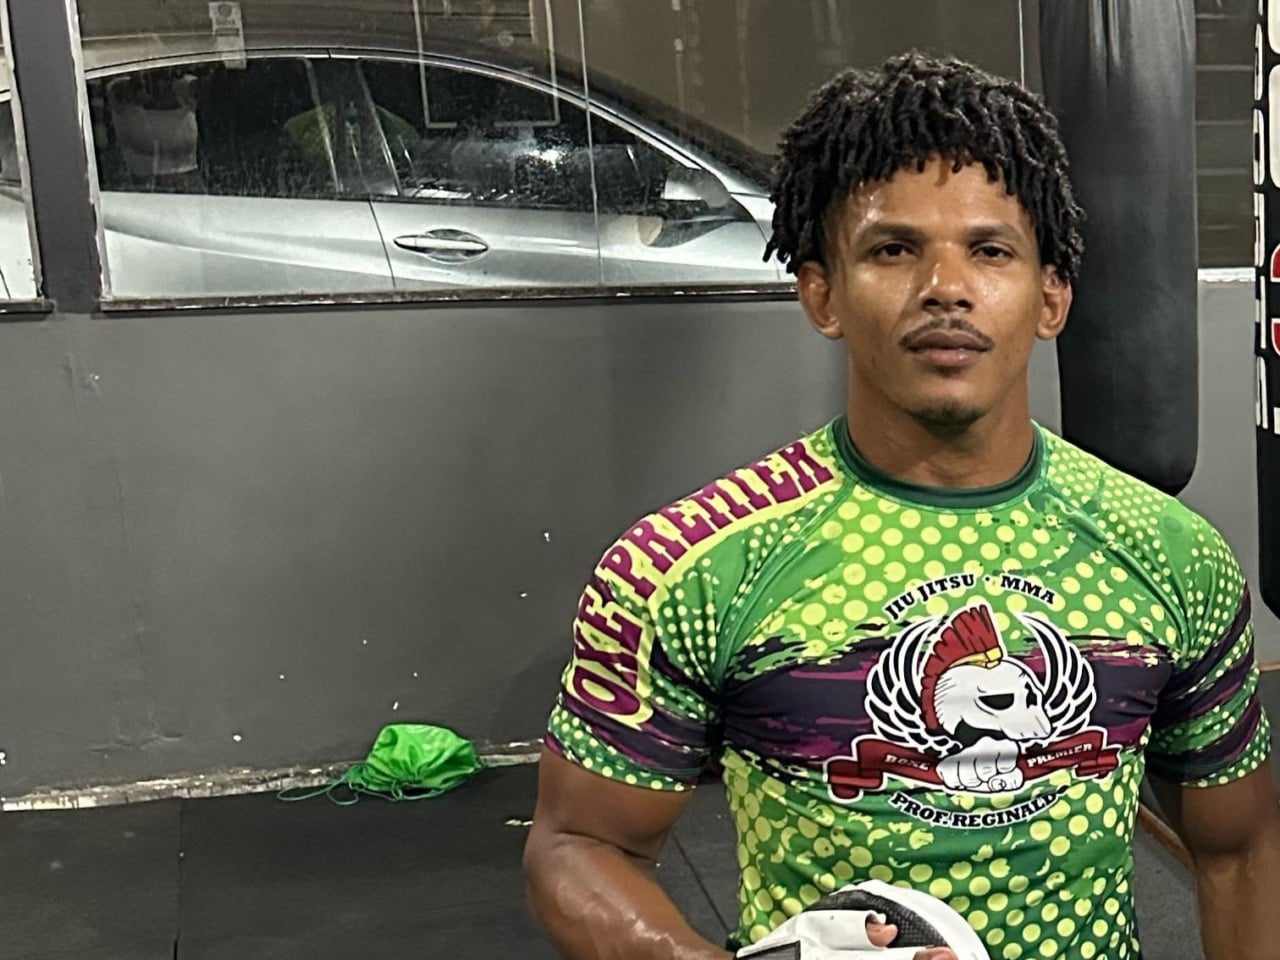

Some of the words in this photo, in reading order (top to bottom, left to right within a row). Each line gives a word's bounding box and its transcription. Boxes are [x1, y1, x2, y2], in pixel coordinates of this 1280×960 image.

[601, 441, 834, 602] PREMIER
[885, 592, 915, 619] JIU
[917, 574, 975, 602] JITSU
[1001, 575, 1055, 605] MMA
